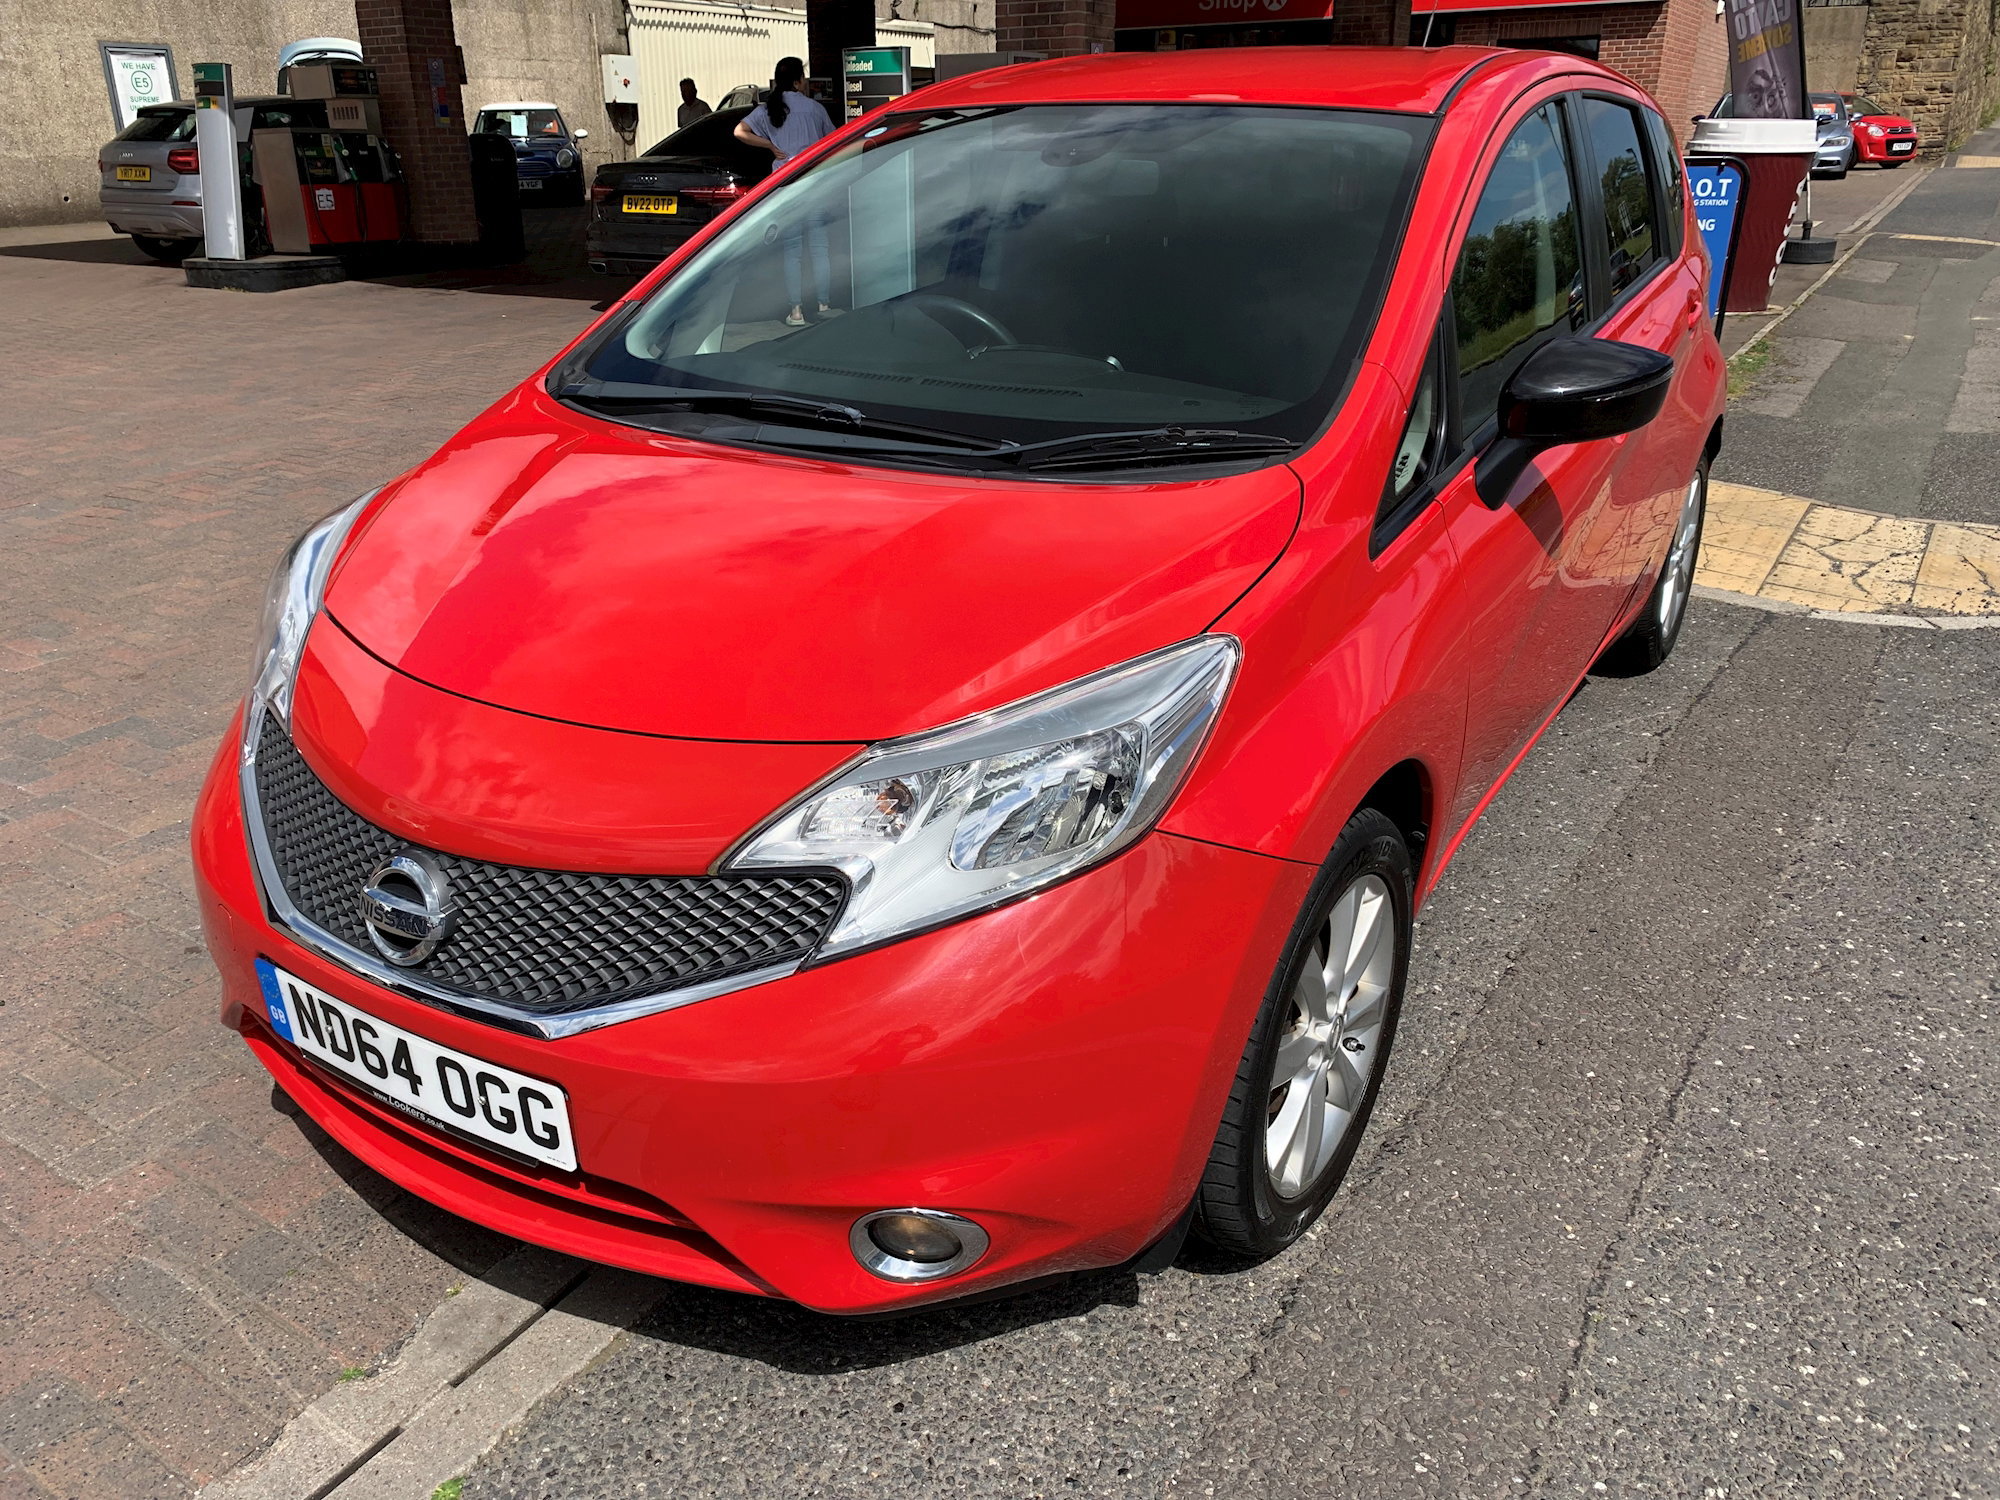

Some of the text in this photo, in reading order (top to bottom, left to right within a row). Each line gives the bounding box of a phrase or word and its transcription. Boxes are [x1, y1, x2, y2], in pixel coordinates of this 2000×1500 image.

[121, 62, 157, 70] WE HAVE
[845, 59, 873, 72] nleaded
[134, 77, 149, 88] E5
[129, 95, 160, 103] SUPREME
[1688, 178, 1733, 197] .O.T
[317, 193, 334, 209] E5
[626, 197, 674, 211] BV22 OTP
[359, 894, 430, 939] NISSAN
[269, 1004, 288, 1025] GB
[287, 983, 562, 1151] ND64 OGG
[371, 1090, 446, 1131] www.Lookers.co.uk
